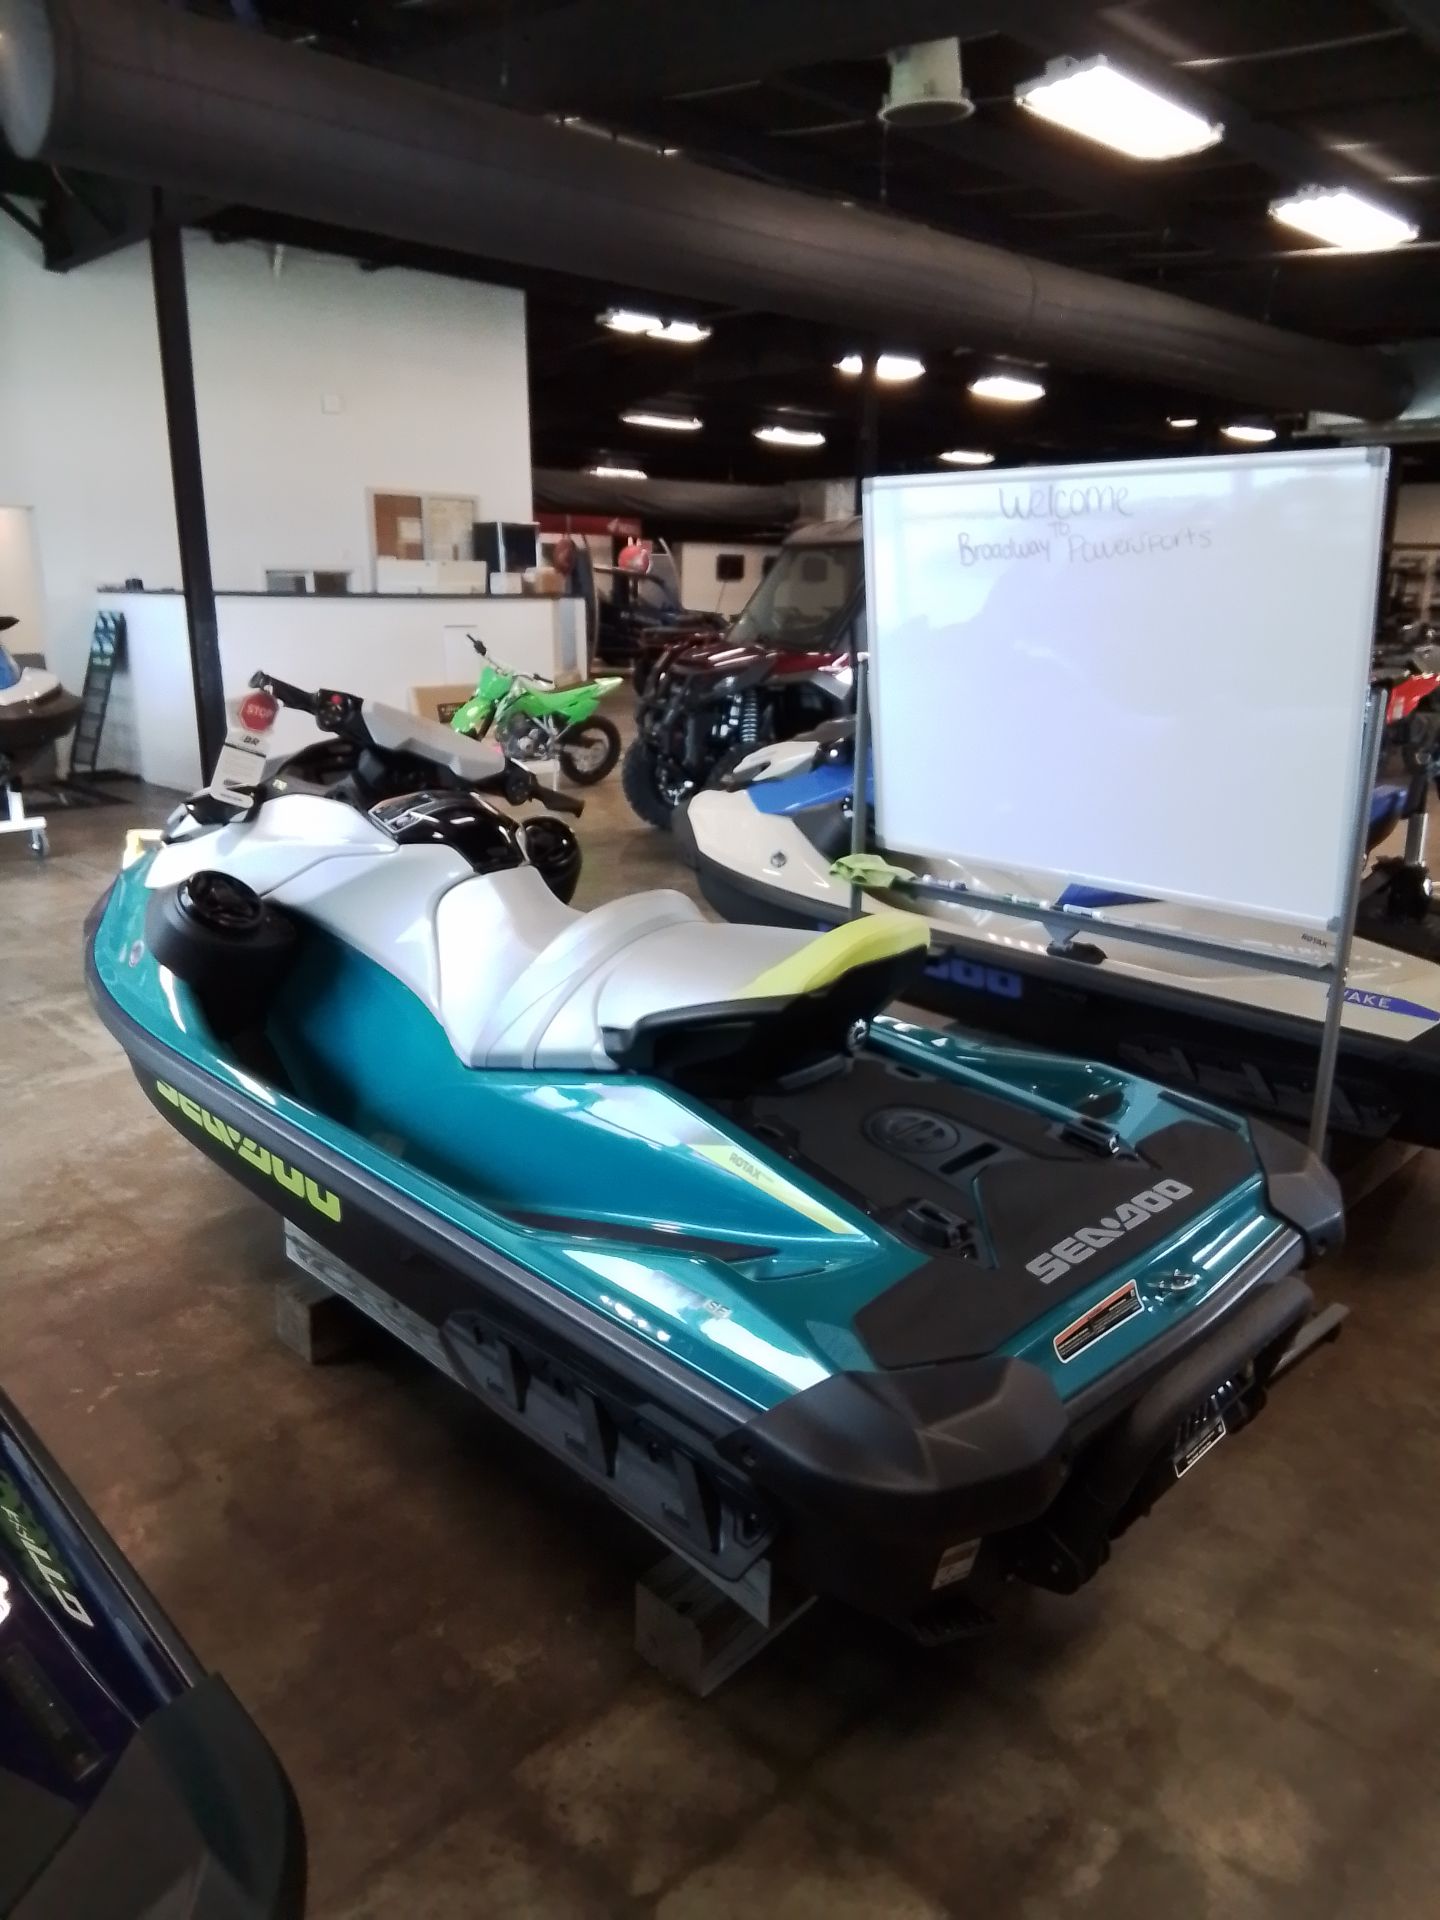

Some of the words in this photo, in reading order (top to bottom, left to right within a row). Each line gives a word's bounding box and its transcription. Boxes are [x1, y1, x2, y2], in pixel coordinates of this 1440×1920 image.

[999, 484, 1134, 520] Welcome
[957, 532, 1051, 567] Broadway
[729, 1152, 762, 1180] ROTAX
